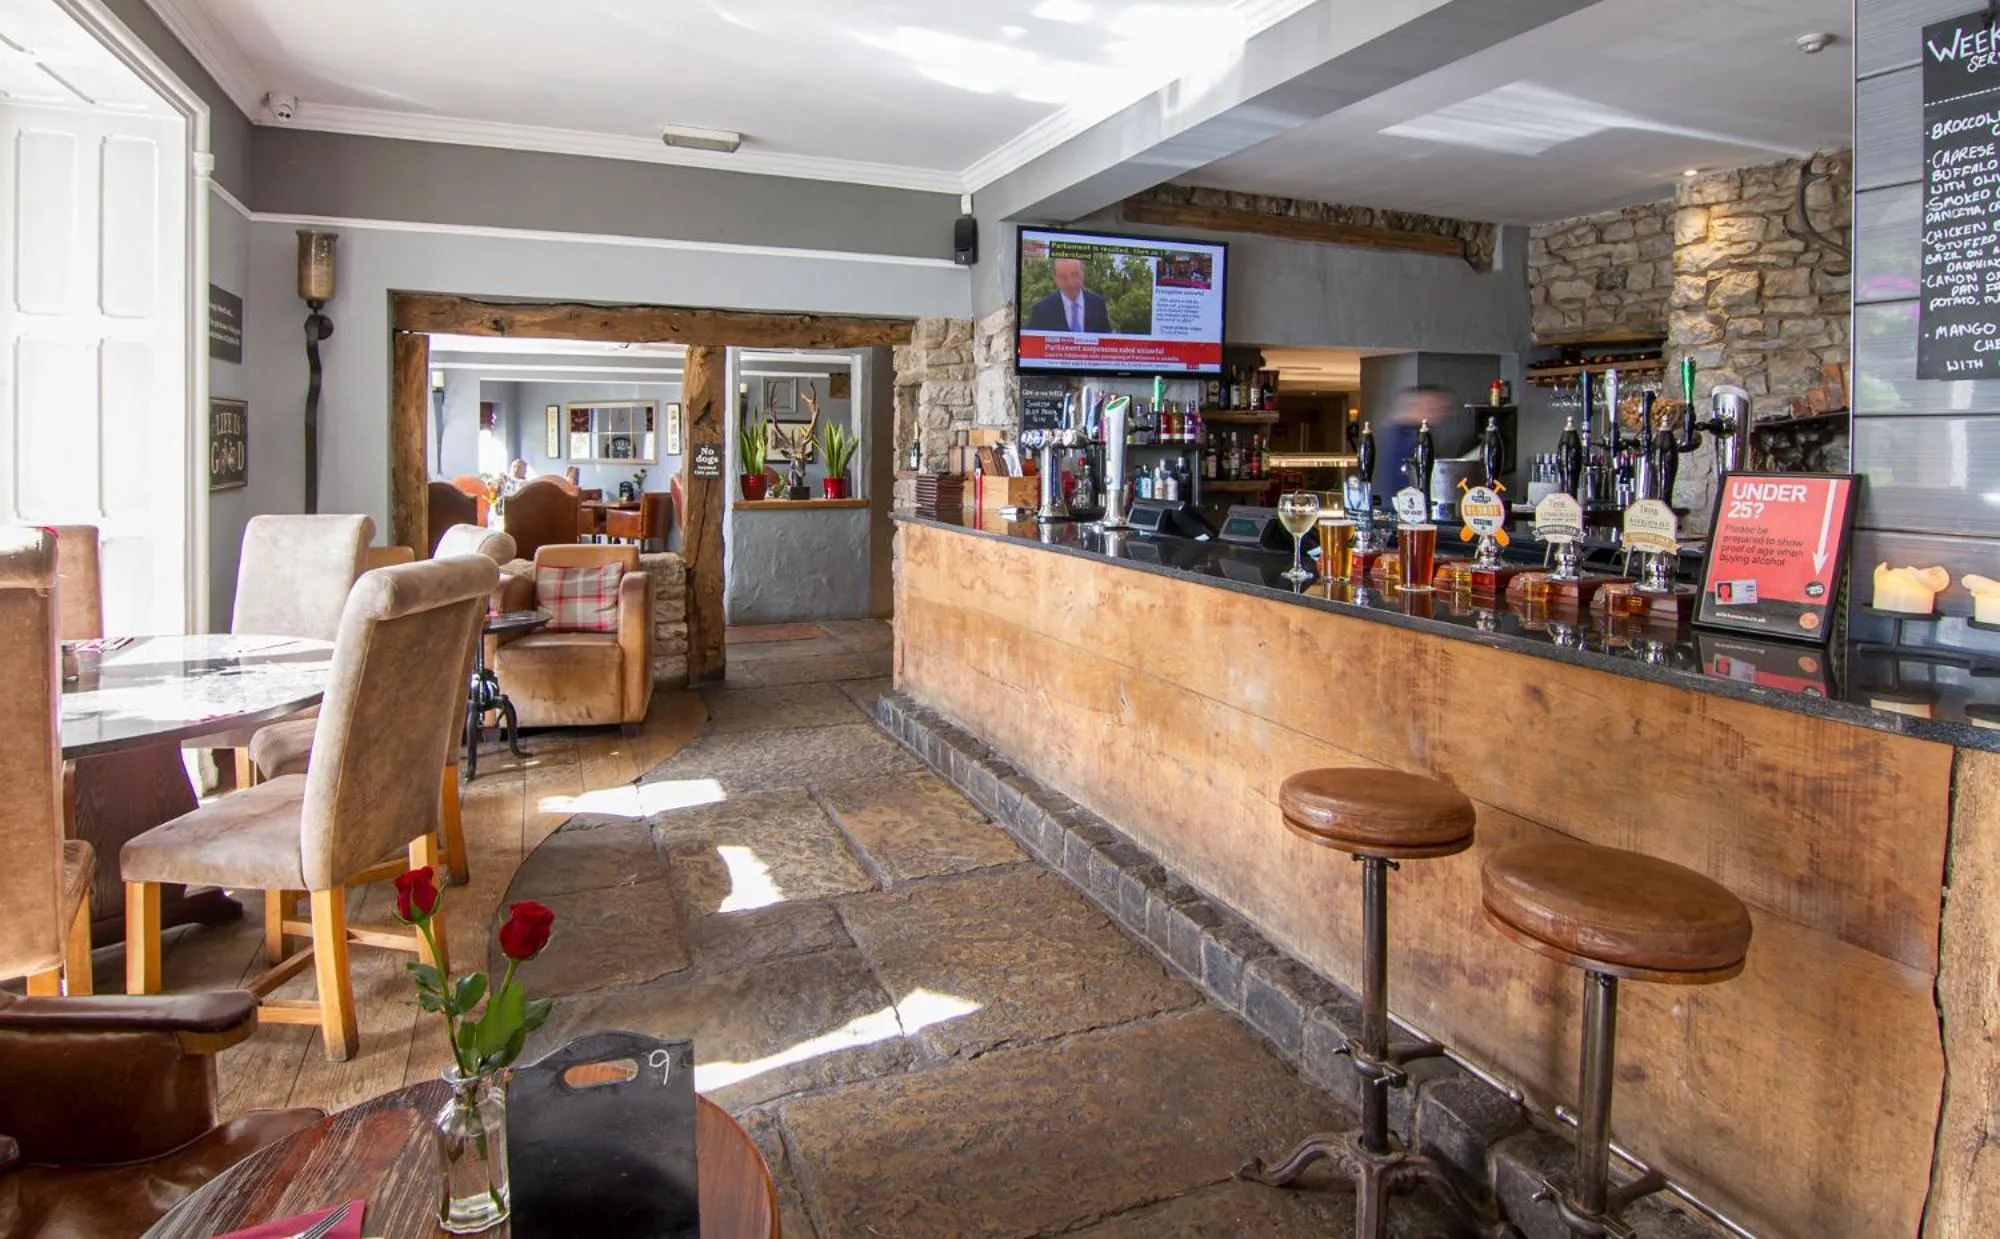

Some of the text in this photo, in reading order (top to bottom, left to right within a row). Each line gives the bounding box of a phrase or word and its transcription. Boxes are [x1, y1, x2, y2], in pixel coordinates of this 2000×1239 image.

[1932, 143, 1995, 169] CAPRESE
[1932, 159, 1998, 182] BUFFALO
[1928, 188, 1991, 212] SMOKED
[1926, 221, 1987, 245] CHICKEN
[1966, 248, 1983, 258] ON
[1927, 271, 1977, 288] CANON
[1951, 283, 1979, 296] PAN
[1935, 322, 1997, 340] MANGO
[1946, 359, 1984, 372] WITH
[216, 413, 233, 436] LIFE
[695, 455, 719, 465] dogs
[700, 447, 714, 456] No
[1732, 482, 1808, 503] UNDER
[1727, 502, 1765, 519] 25?
[1724, 523, 1768, 534] Please be
[1721, 543, 1803, 557] proof of age when
[1722, 535, 1804, 548] prepared to show
[1719, 554, 1785, 566] buying alcohol
[650, 1049, 671, 1087] 9
